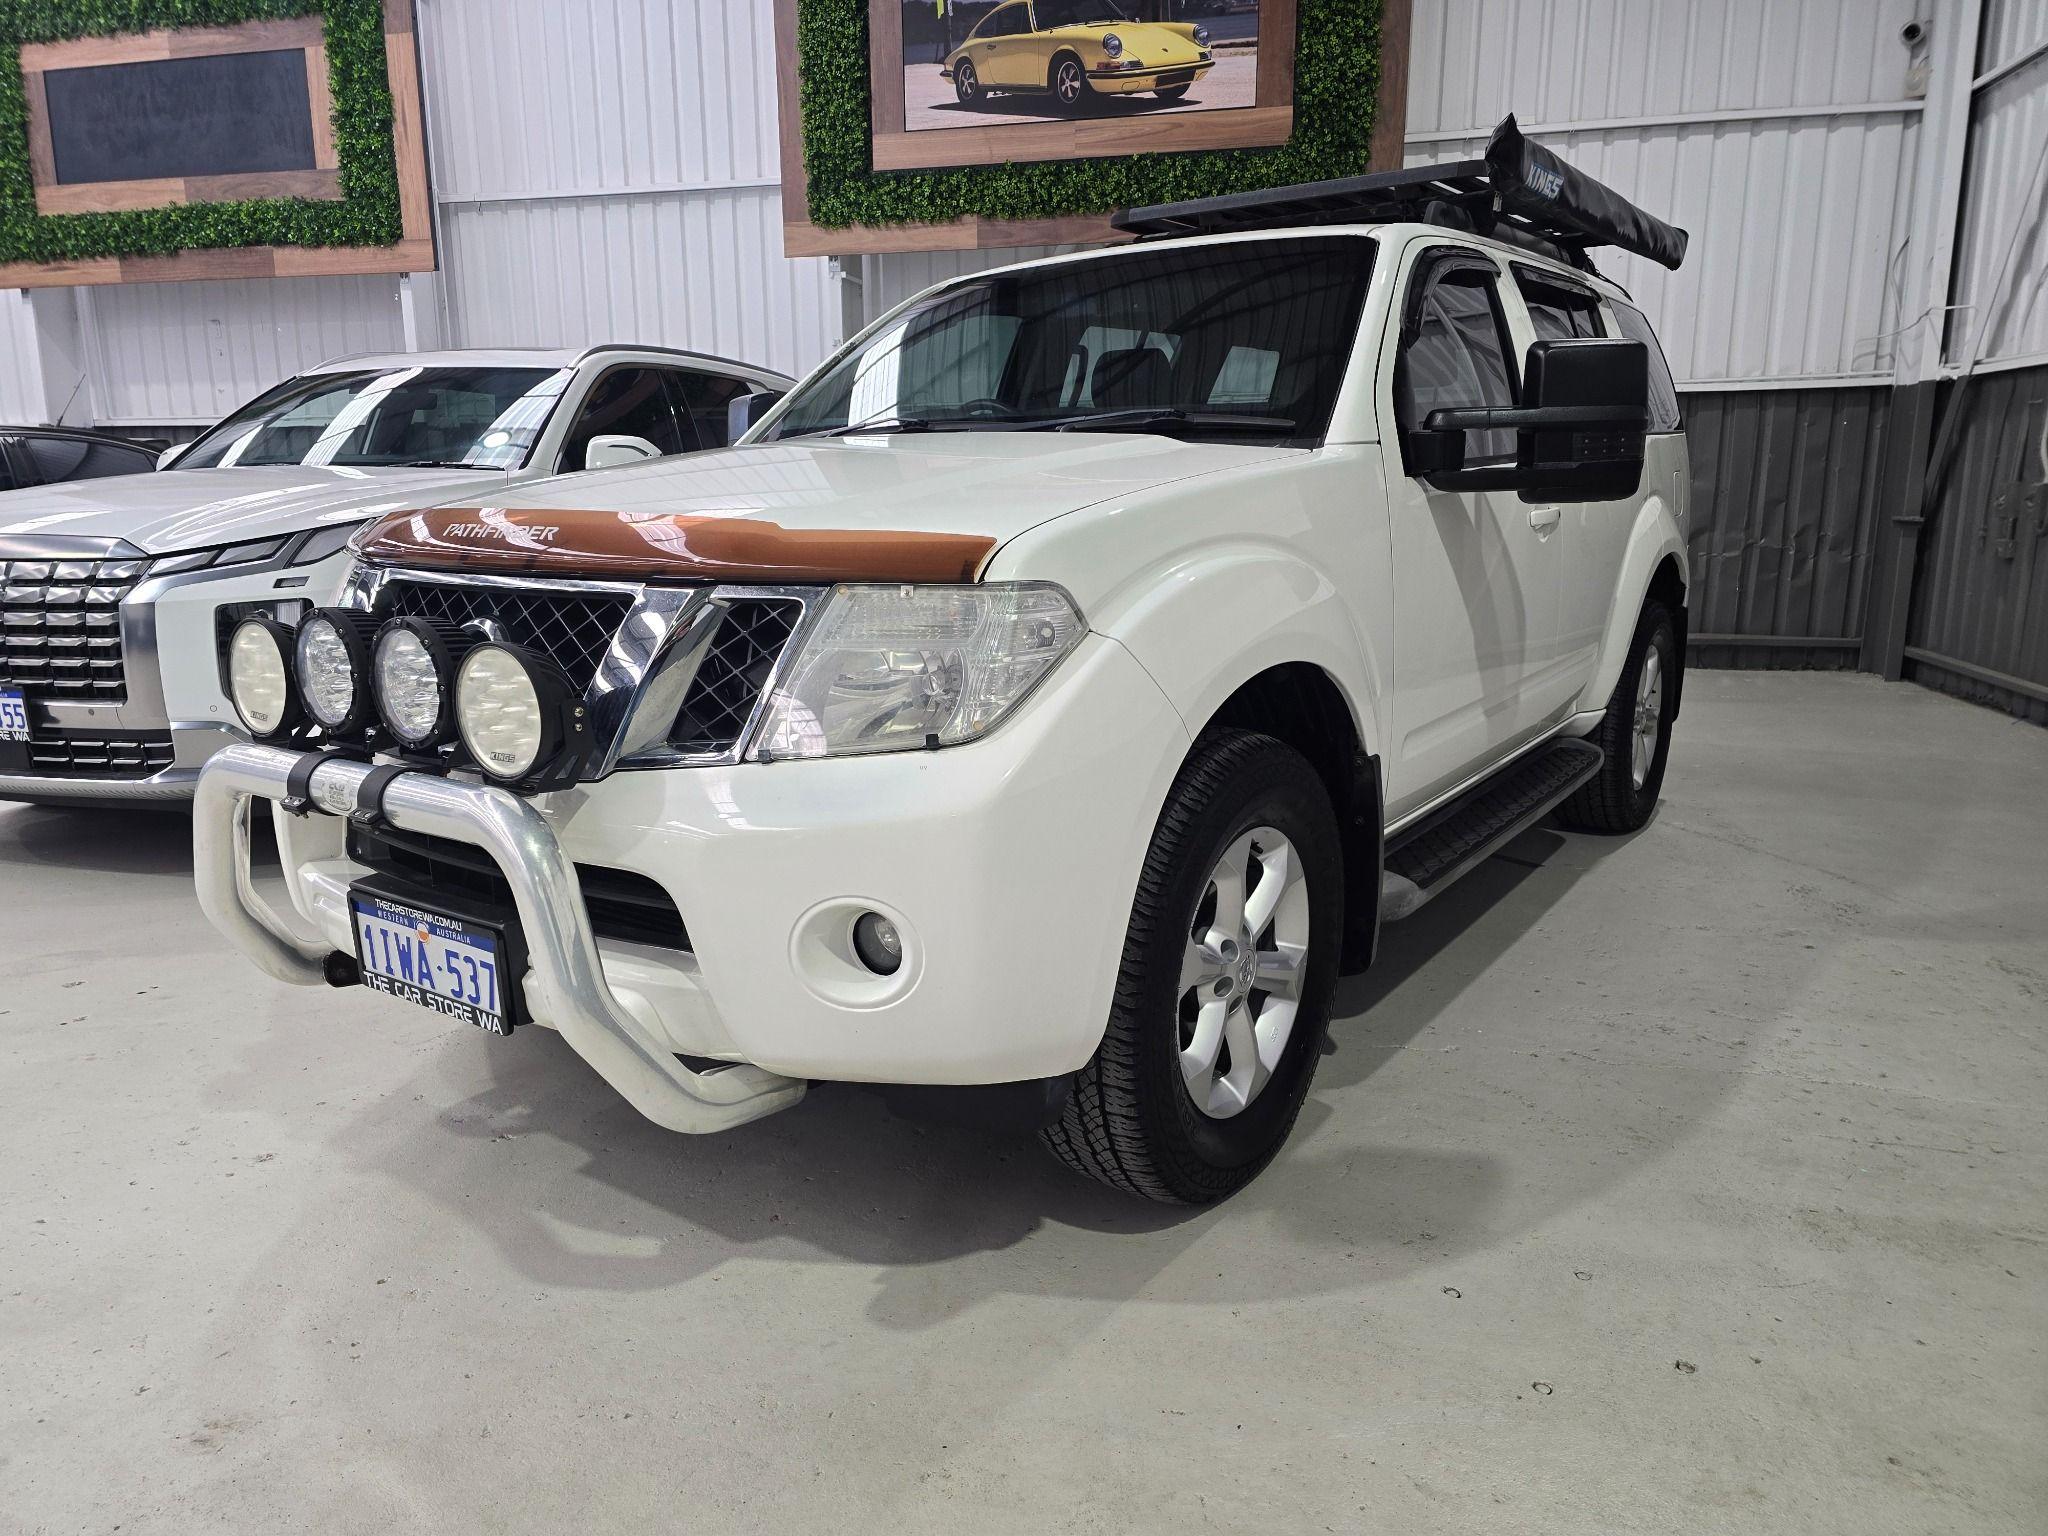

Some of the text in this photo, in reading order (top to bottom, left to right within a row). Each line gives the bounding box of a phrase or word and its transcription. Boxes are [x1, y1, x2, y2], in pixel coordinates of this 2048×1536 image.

[1525, 164, 1564, 200] KINGS
[0, 703, 26, 729] 55
[12, 731, 31, 742] WA
[490, 752, 515, 763] KINGS
[377, 910, 471, 945] WESTERN AUSTRALIA
[364, 971, 503, 1036] THE CAR STORE WA
